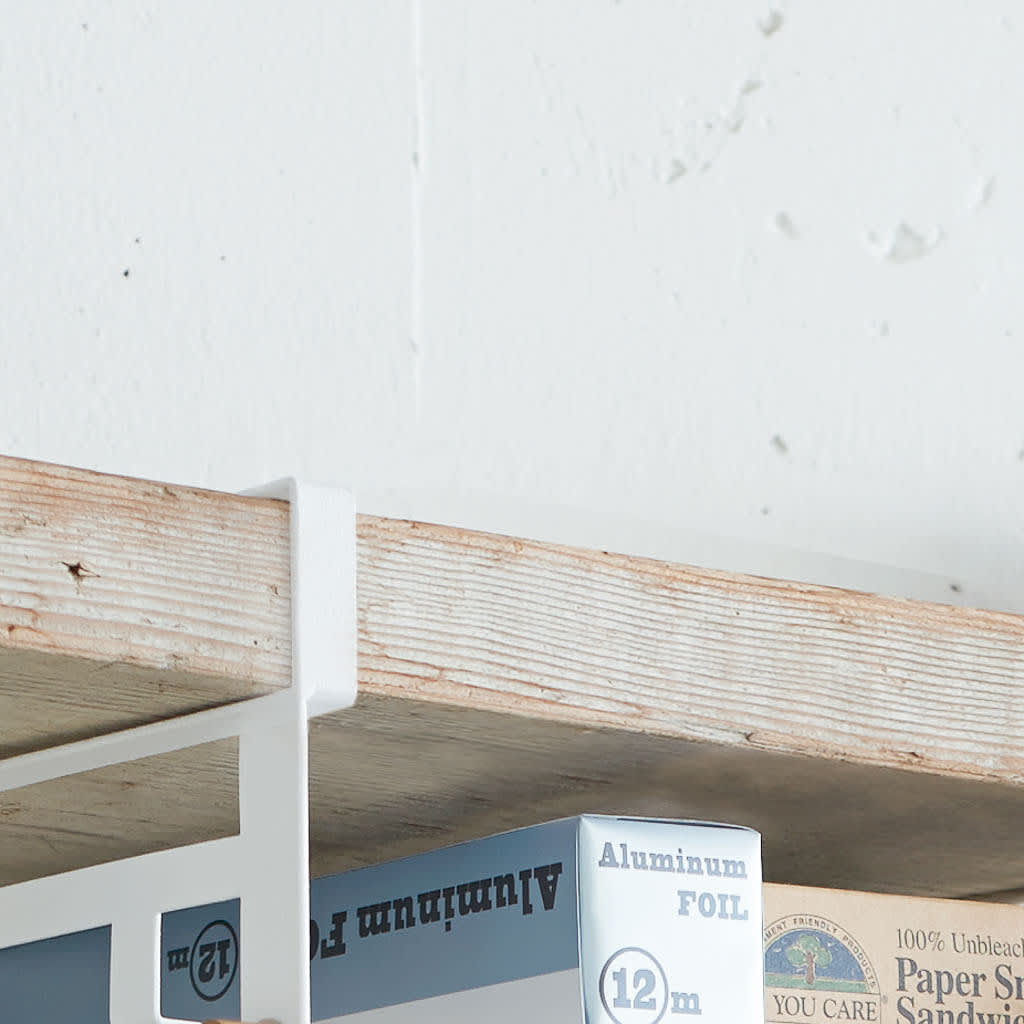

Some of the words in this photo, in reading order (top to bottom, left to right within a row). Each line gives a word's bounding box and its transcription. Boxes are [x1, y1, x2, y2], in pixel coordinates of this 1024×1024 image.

[599, 841, 748, 879] Aluminum
[356, 862, 563, 938] Aluminum
[677, 890, 749, 921] FOIL
[896, 928, 945, 951] 100%
[895, 957, 986, 1005] Paper
[773, 994, 816, 1017] YOU
[822, 998, 877, 1022] CARE
